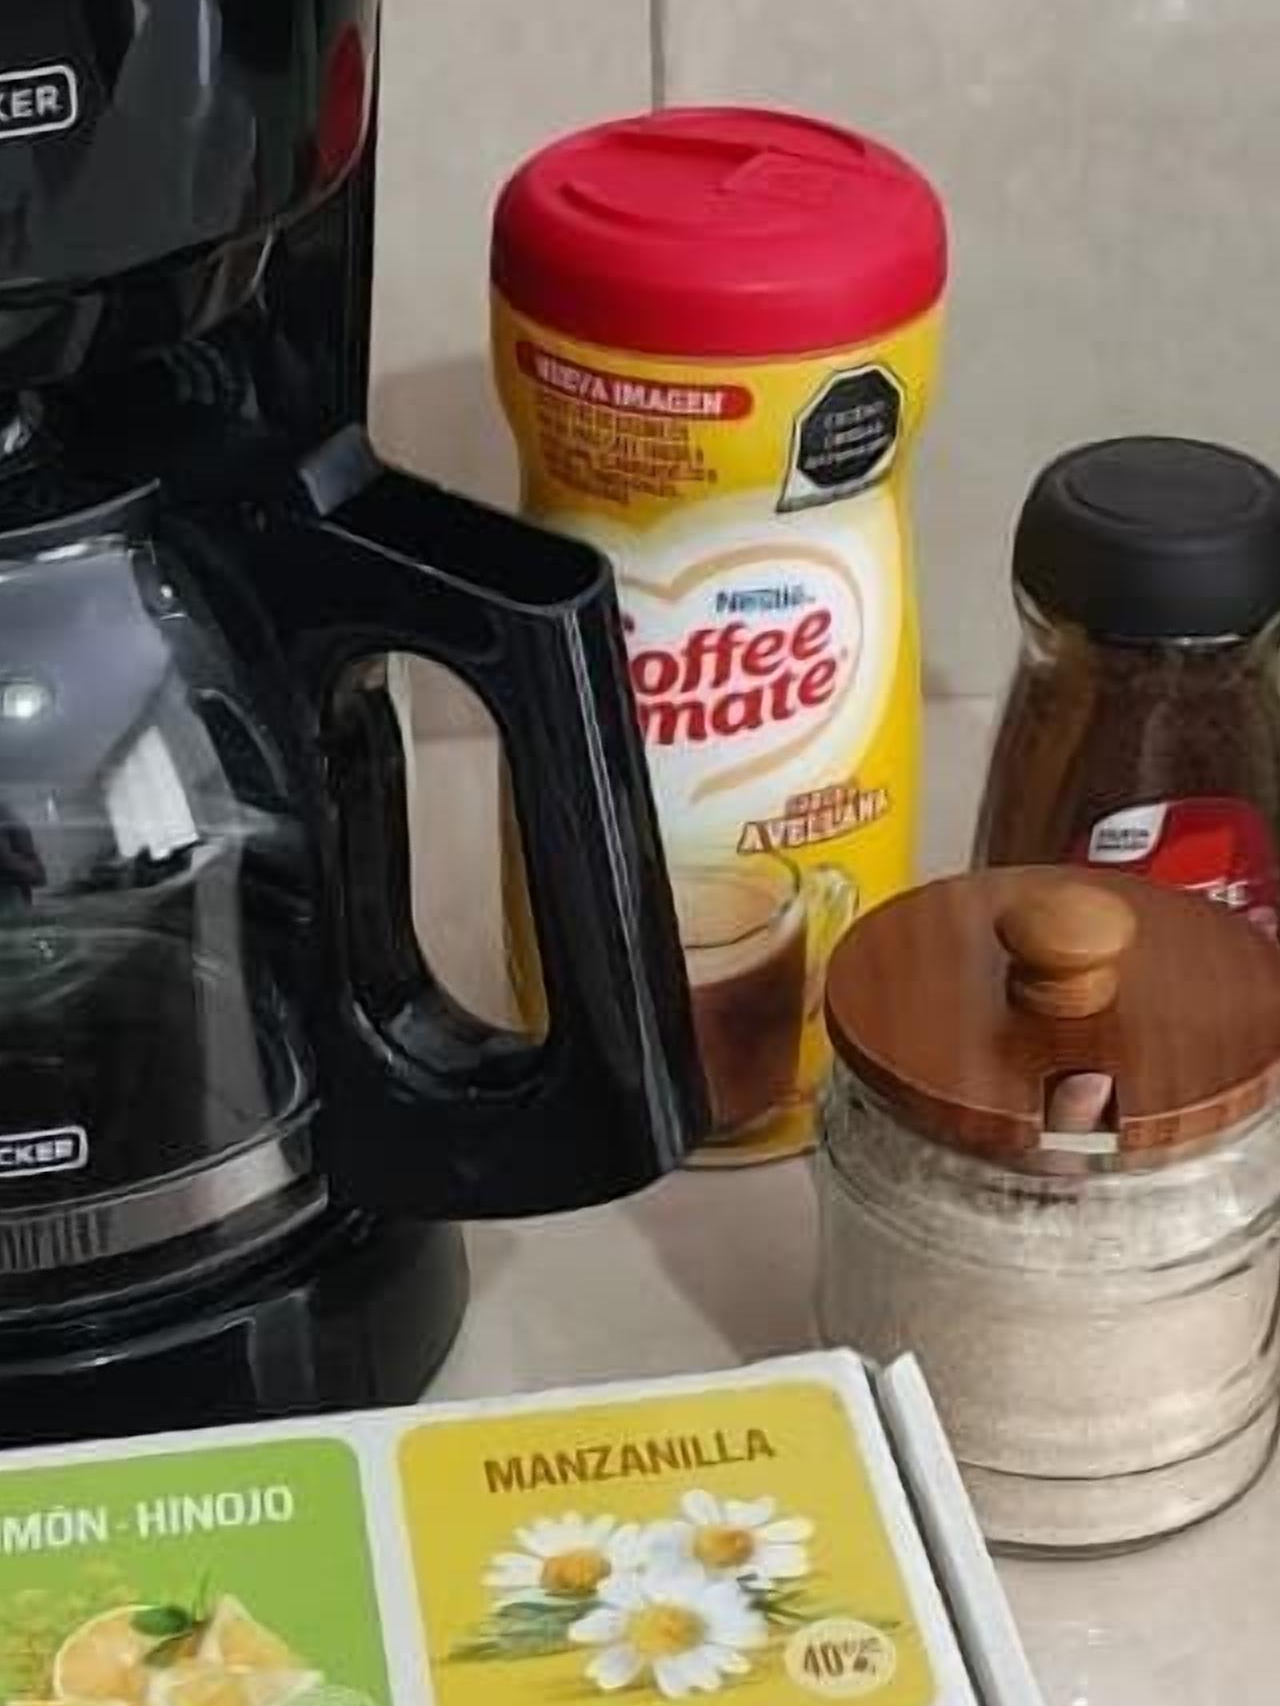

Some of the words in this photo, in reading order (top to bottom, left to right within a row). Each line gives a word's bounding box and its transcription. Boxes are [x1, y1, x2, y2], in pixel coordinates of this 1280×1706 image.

[622, 607, 833, 696] offee
[637, 657, 838, 747] mate
[483, 1427, 776, 1495] MANZANILLA
[136, 1483, 296, 1539] HINOJO
